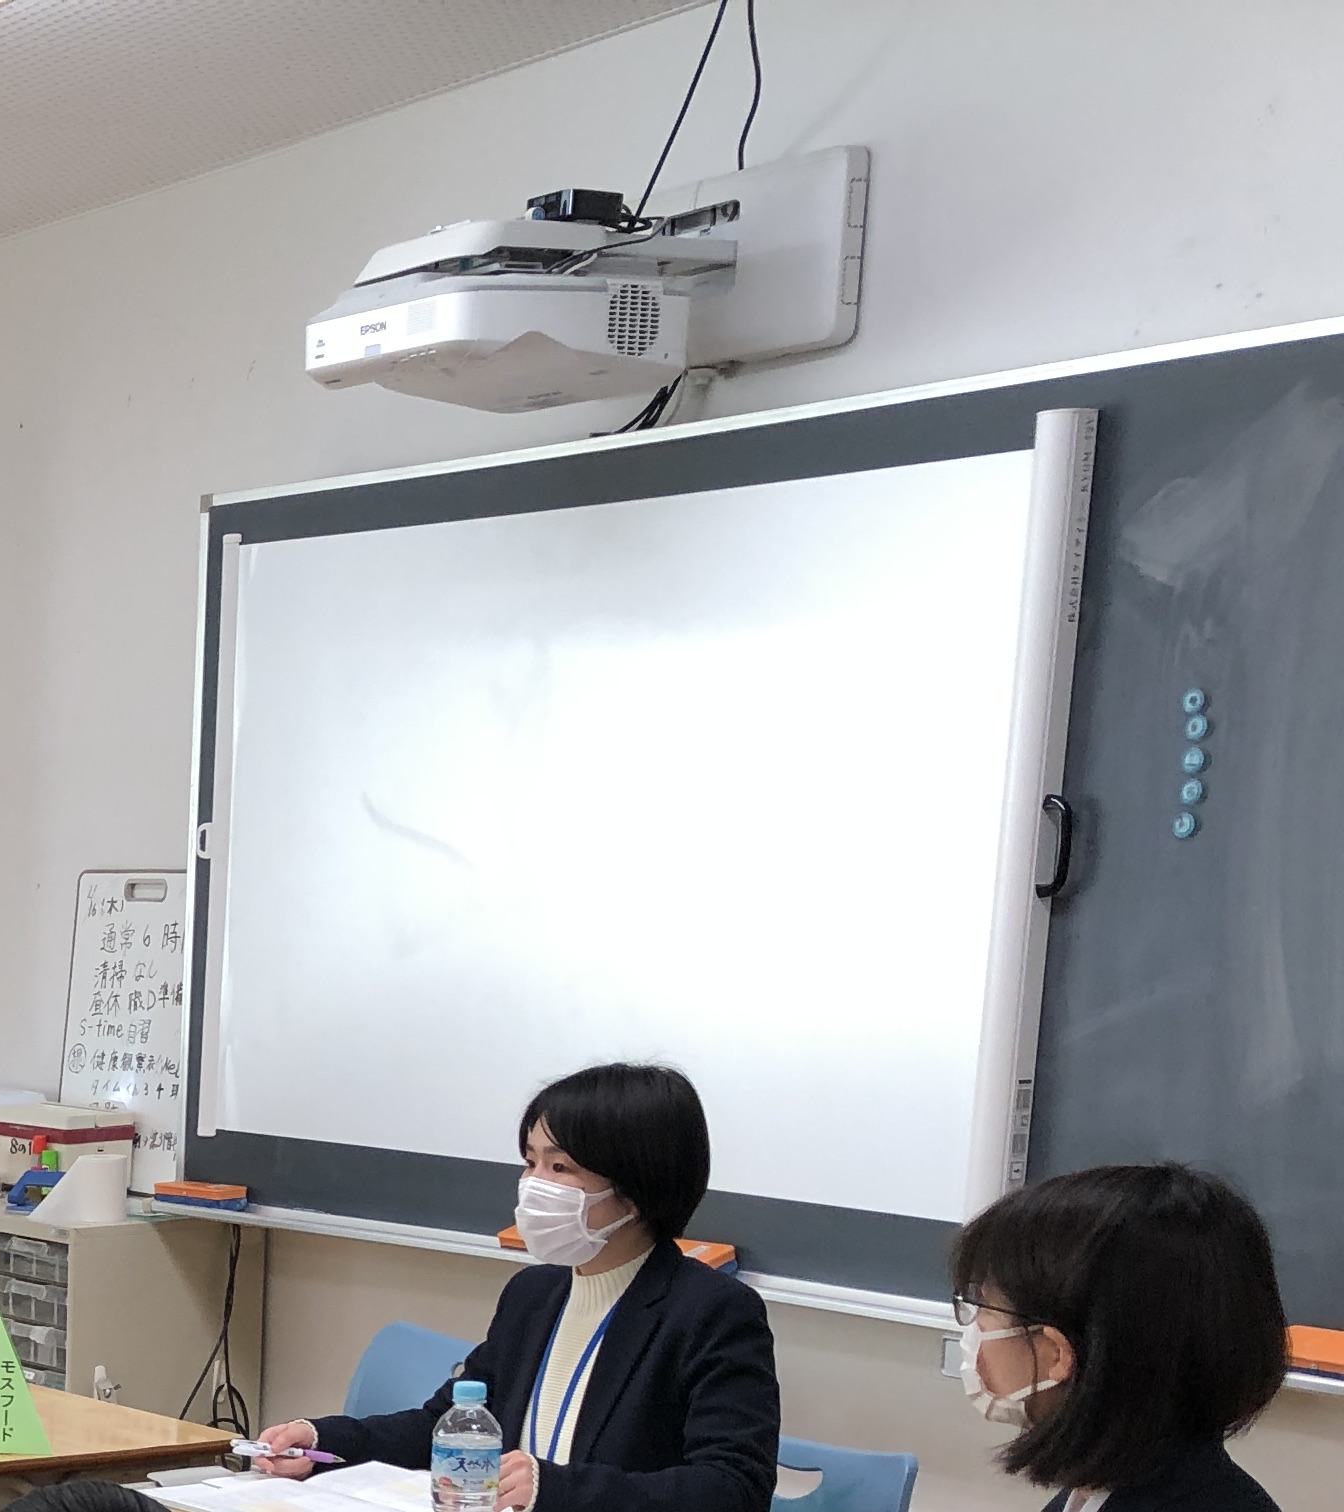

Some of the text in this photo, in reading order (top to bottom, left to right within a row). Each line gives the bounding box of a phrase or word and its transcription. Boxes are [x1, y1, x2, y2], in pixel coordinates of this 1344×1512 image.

[360, 321, 387, 336] EPSON
[100, 920, 184, 957] 通常6時
[0, 1360, 16, 1442] モスフード
